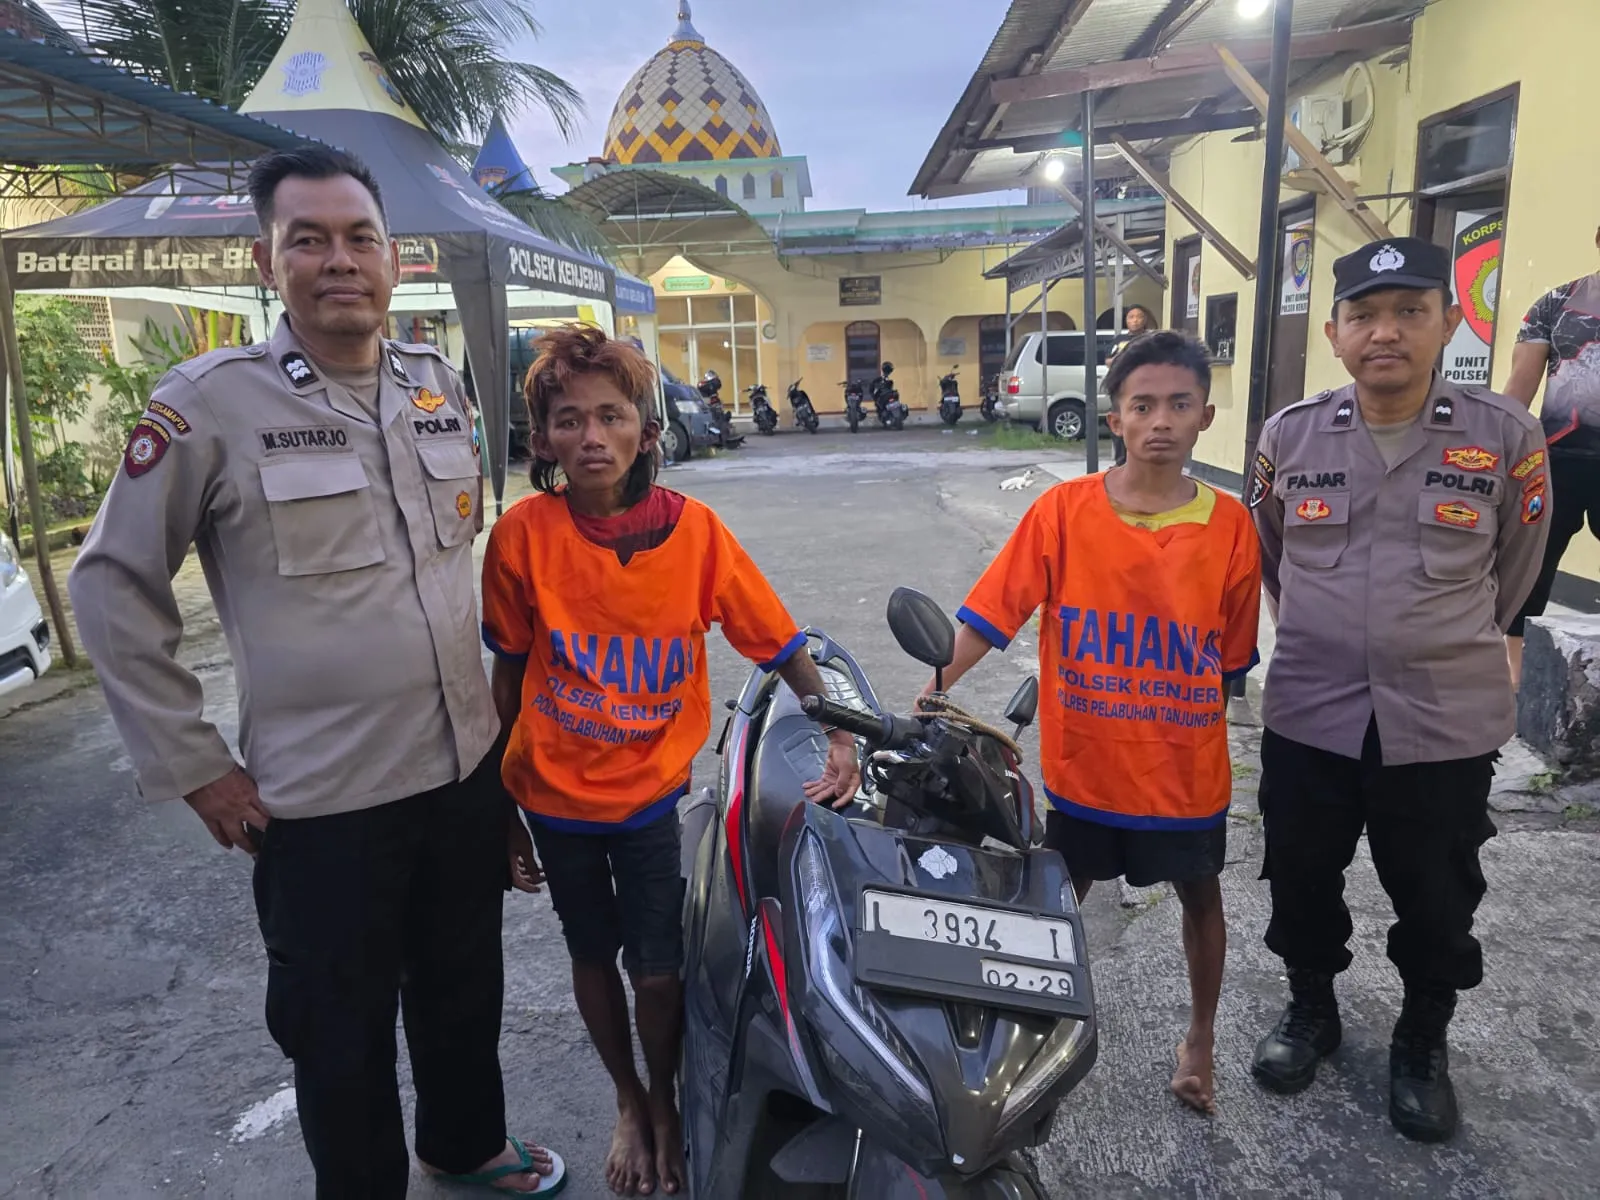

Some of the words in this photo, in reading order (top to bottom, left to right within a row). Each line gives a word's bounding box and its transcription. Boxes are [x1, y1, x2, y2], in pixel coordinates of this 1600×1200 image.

[1462, 220, 1503, 246] KORPS
[17, 250, 134, 274] Baterai
[143, 249, 216, 271] Luar
[222, 247, 258, 270] Bi
[509, 247, 556, 283] POLSEK
[557, 256, 606, 294] KENJERAN
[1455, 356, 1488, 368] UNIT
[413, 417, 462, 436] POLRI
[262, 429, 347, 450] M.SUTARJO
[1287, 472, 1346, 490] FAJAR
[1425, 471, 1495, 496] POLRI
[1139, 679, 1219, 704] KENJER
[1090, 699, 1158, 721] PELABUHAN
[1160, 706, 1209, 728] TANJUNG
[873, 901, 891, 935] L
[923, 909, 1002, 951] 3934
